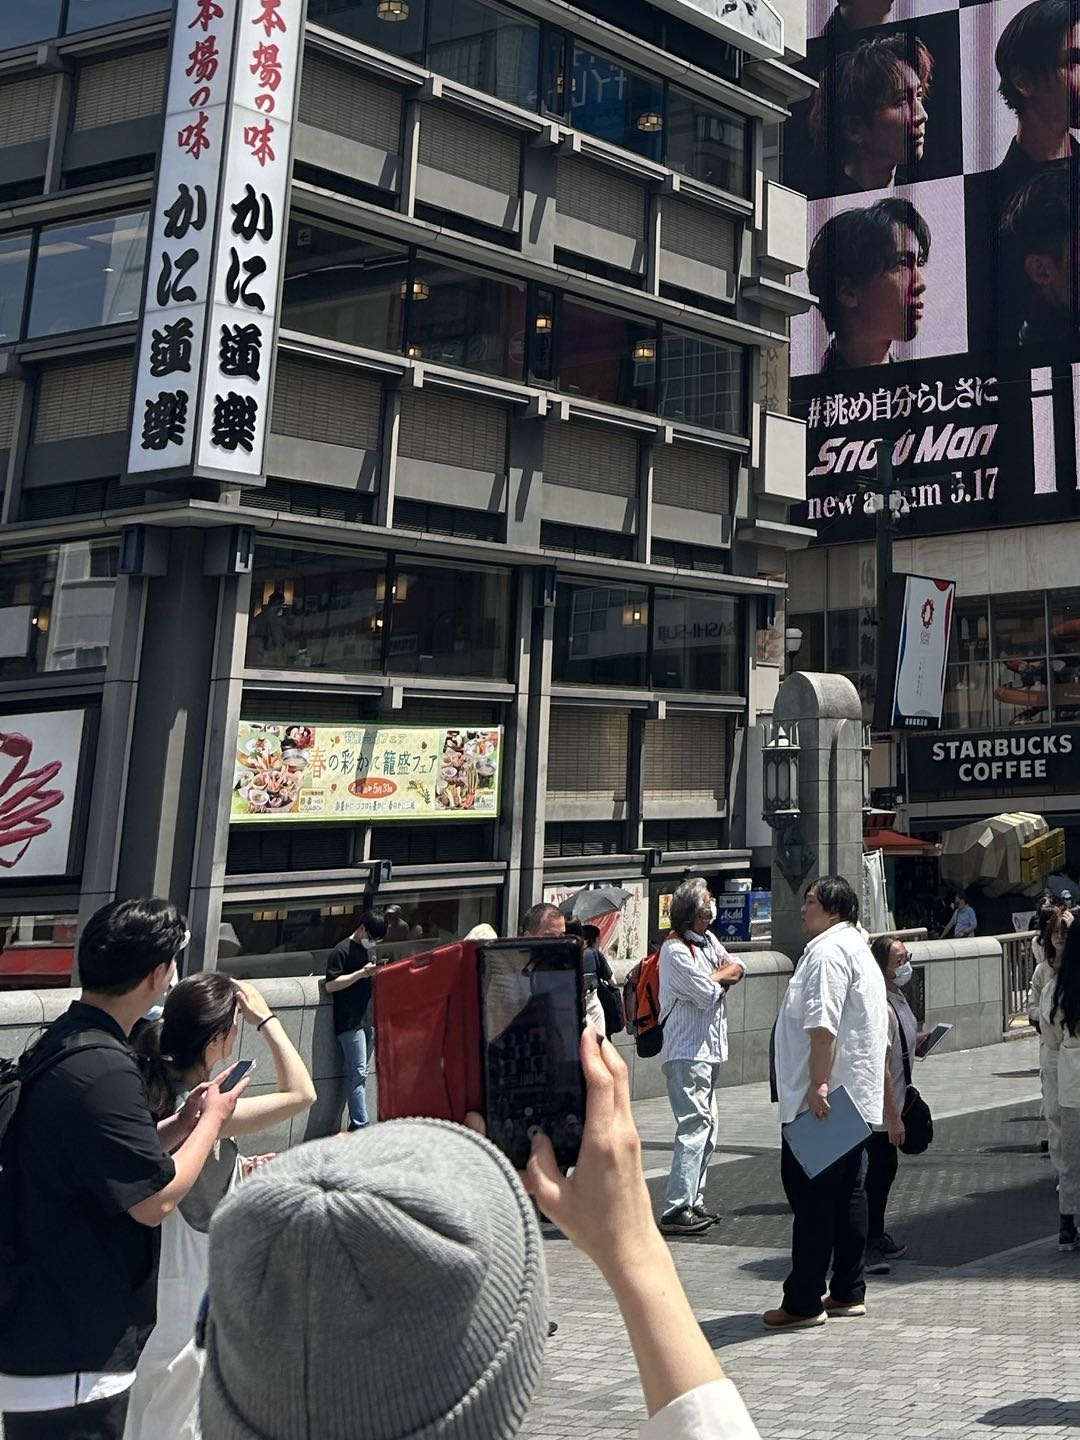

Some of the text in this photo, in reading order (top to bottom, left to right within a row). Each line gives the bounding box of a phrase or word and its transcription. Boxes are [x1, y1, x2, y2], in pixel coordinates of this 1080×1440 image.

[141, 183, 207, 454] かに道楽
[210, 183, 274, 455] かに道楽
[914, 423, 998, 464] Man
[808, 493, 857, 520] new
[932, 734, 1073, 761] STARBUCKS
[958, 759, 1048, 782] COFFEE
